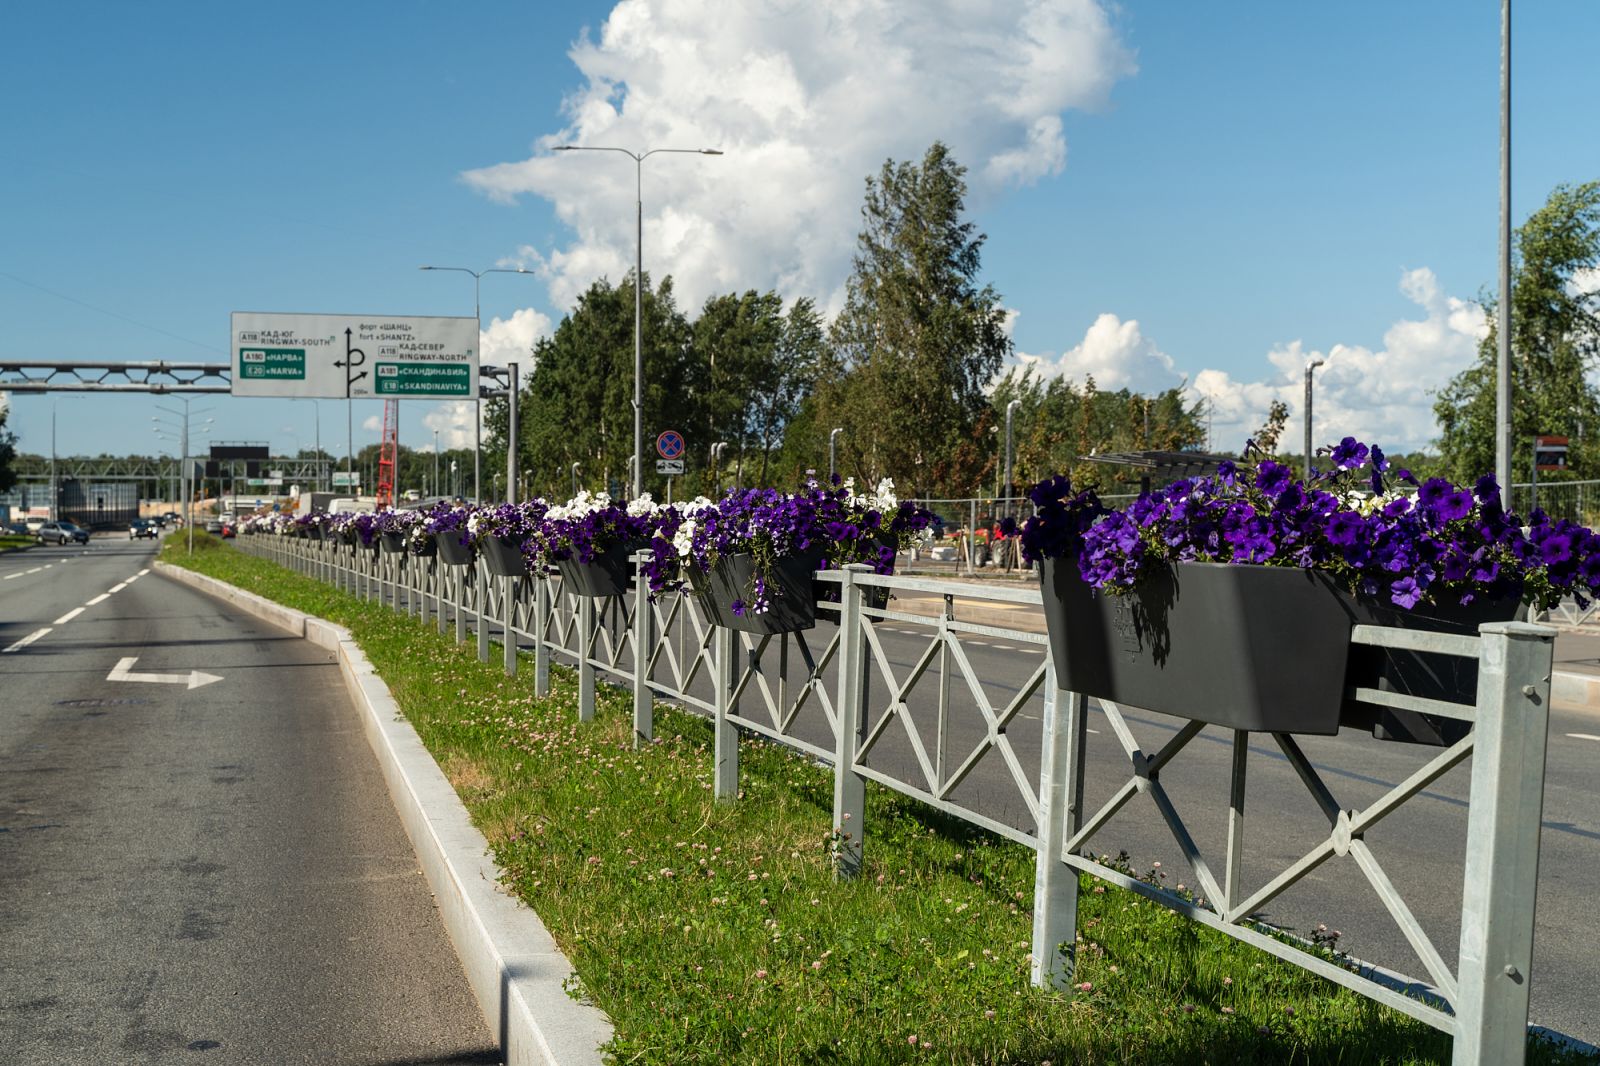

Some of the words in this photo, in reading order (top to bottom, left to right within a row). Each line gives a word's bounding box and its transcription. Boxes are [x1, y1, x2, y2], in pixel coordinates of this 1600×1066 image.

[376, 333, 415, 341] «SHANTZ»
[260, 338, 331, 346] RINGWAY-SOUTH
[399, 343, 445, 351] КАД-СЕВЕР
[266, 367, 303, 375] «NARVA»
